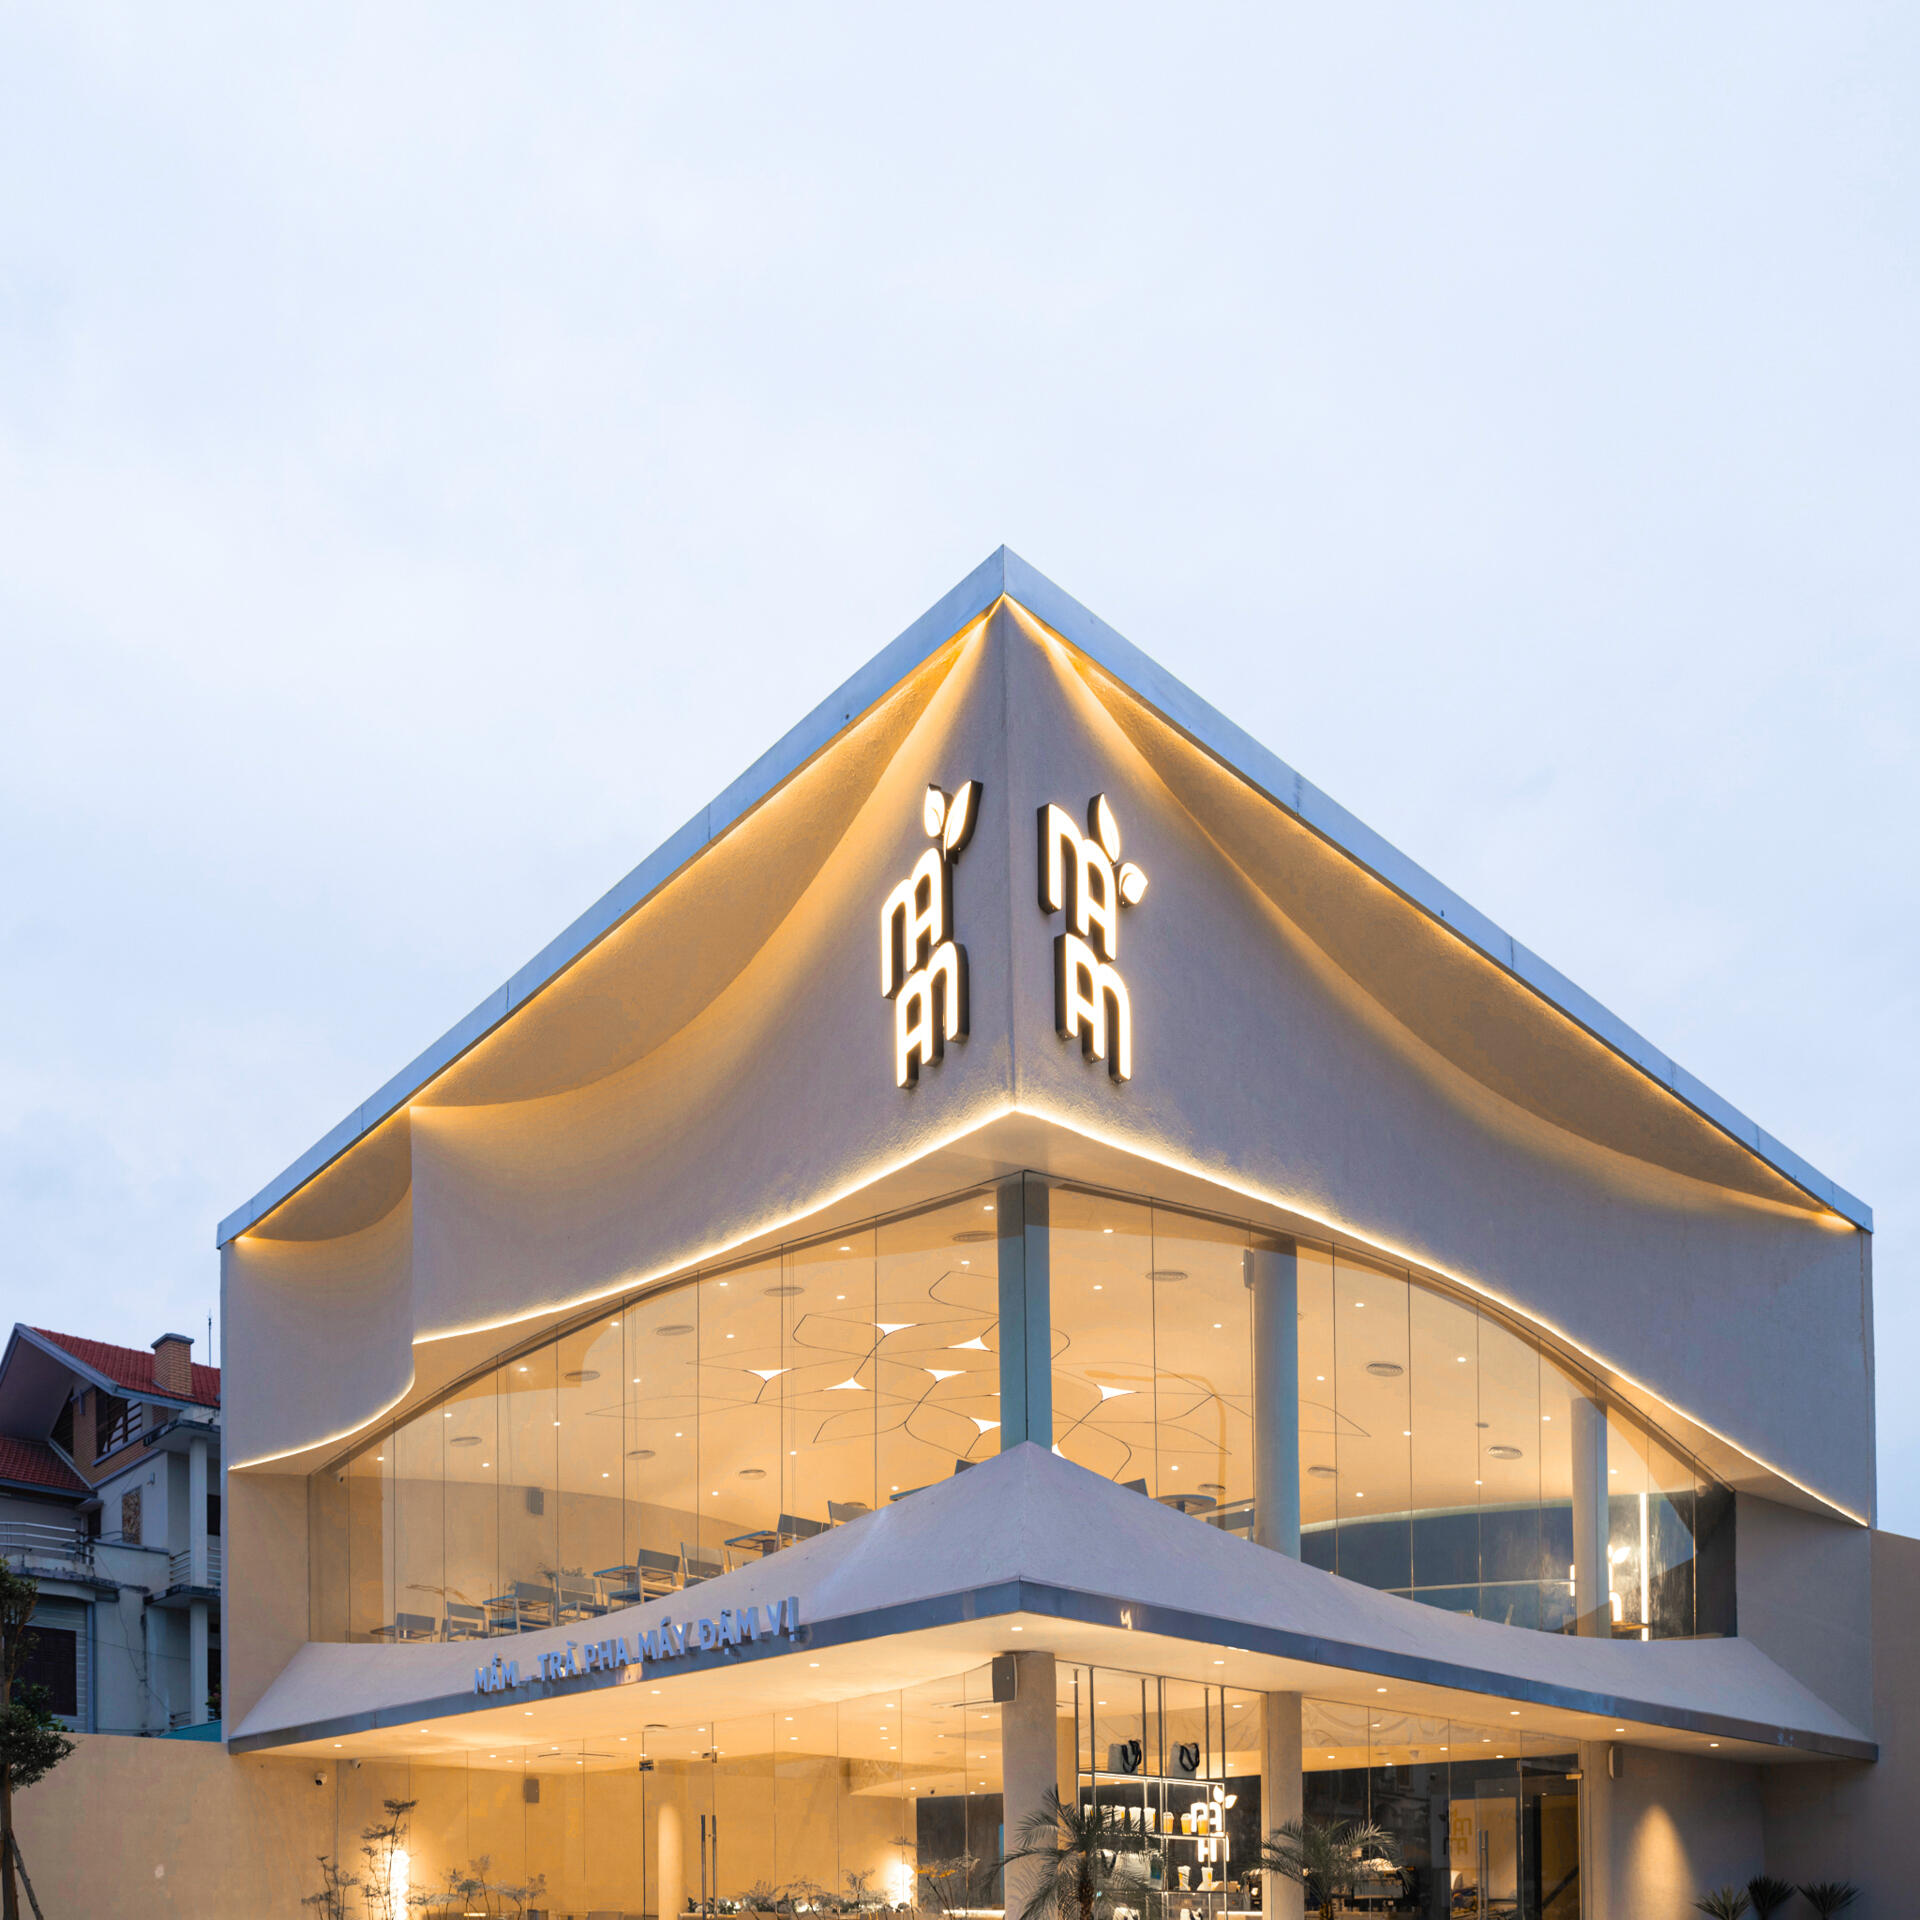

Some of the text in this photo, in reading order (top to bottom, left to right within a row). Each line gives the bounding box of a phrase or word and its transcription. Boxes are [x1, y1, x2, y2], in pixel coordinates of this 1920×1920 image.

[537, 1641, 580, 1681] TRÀ
[584, 1636, 629, 1673] PHA
[638, 1616, 692, 1661] MÁY
